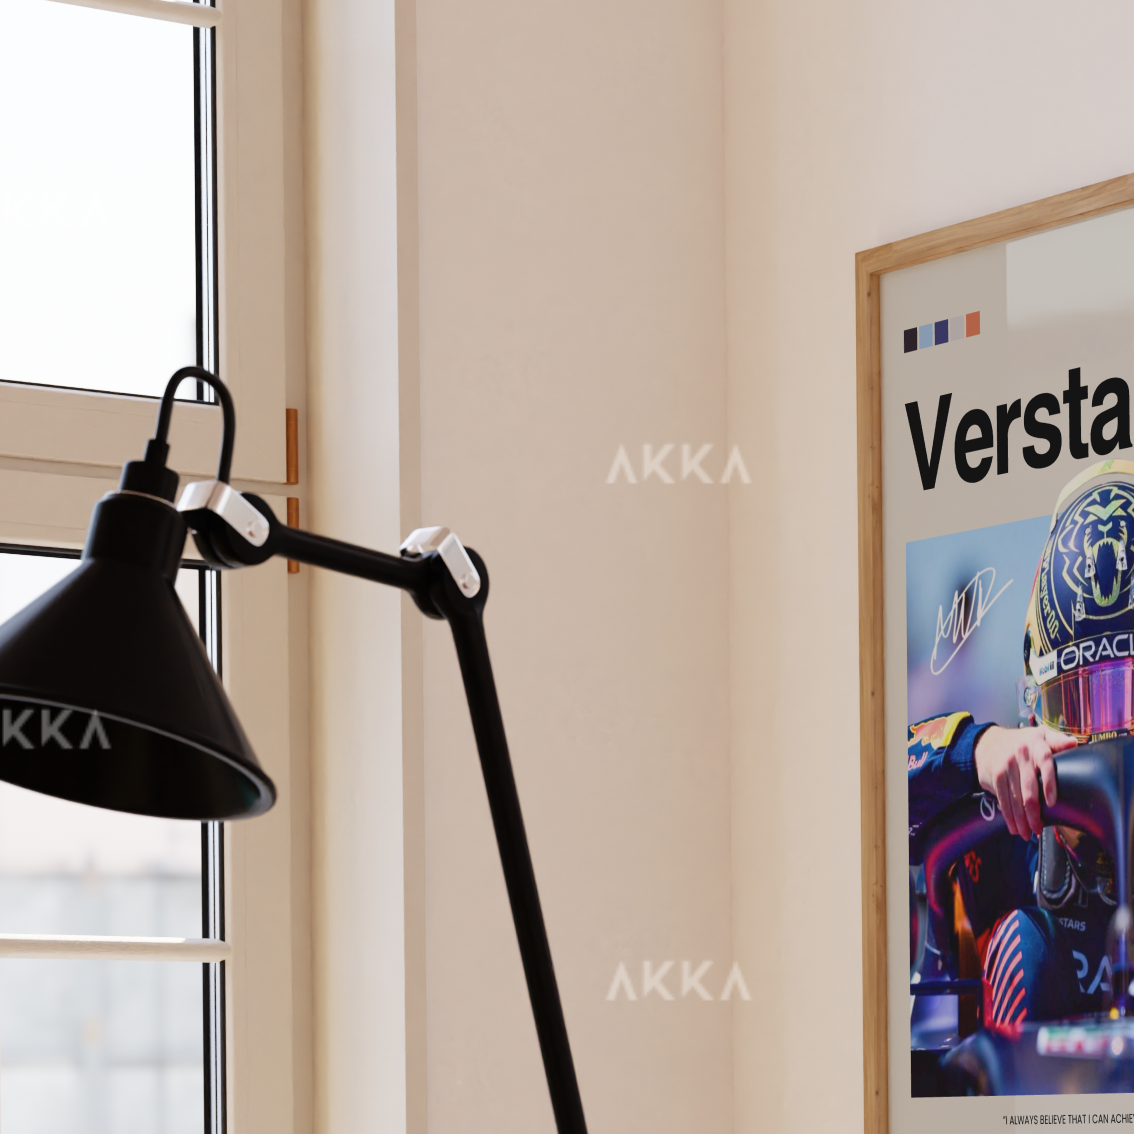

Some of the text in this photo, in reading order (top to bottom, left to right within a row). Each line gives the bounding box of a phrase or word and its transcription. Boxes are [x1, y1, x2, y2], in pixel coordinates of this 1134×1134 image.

[1010, 1115, 1038, 1125] ALWAYS
[1040, 1114, 1066, 1125] BELIEVE
[1068, 1114, 1086, 1124] THAT
[1092, 1114, 1109, 1124] CAN
